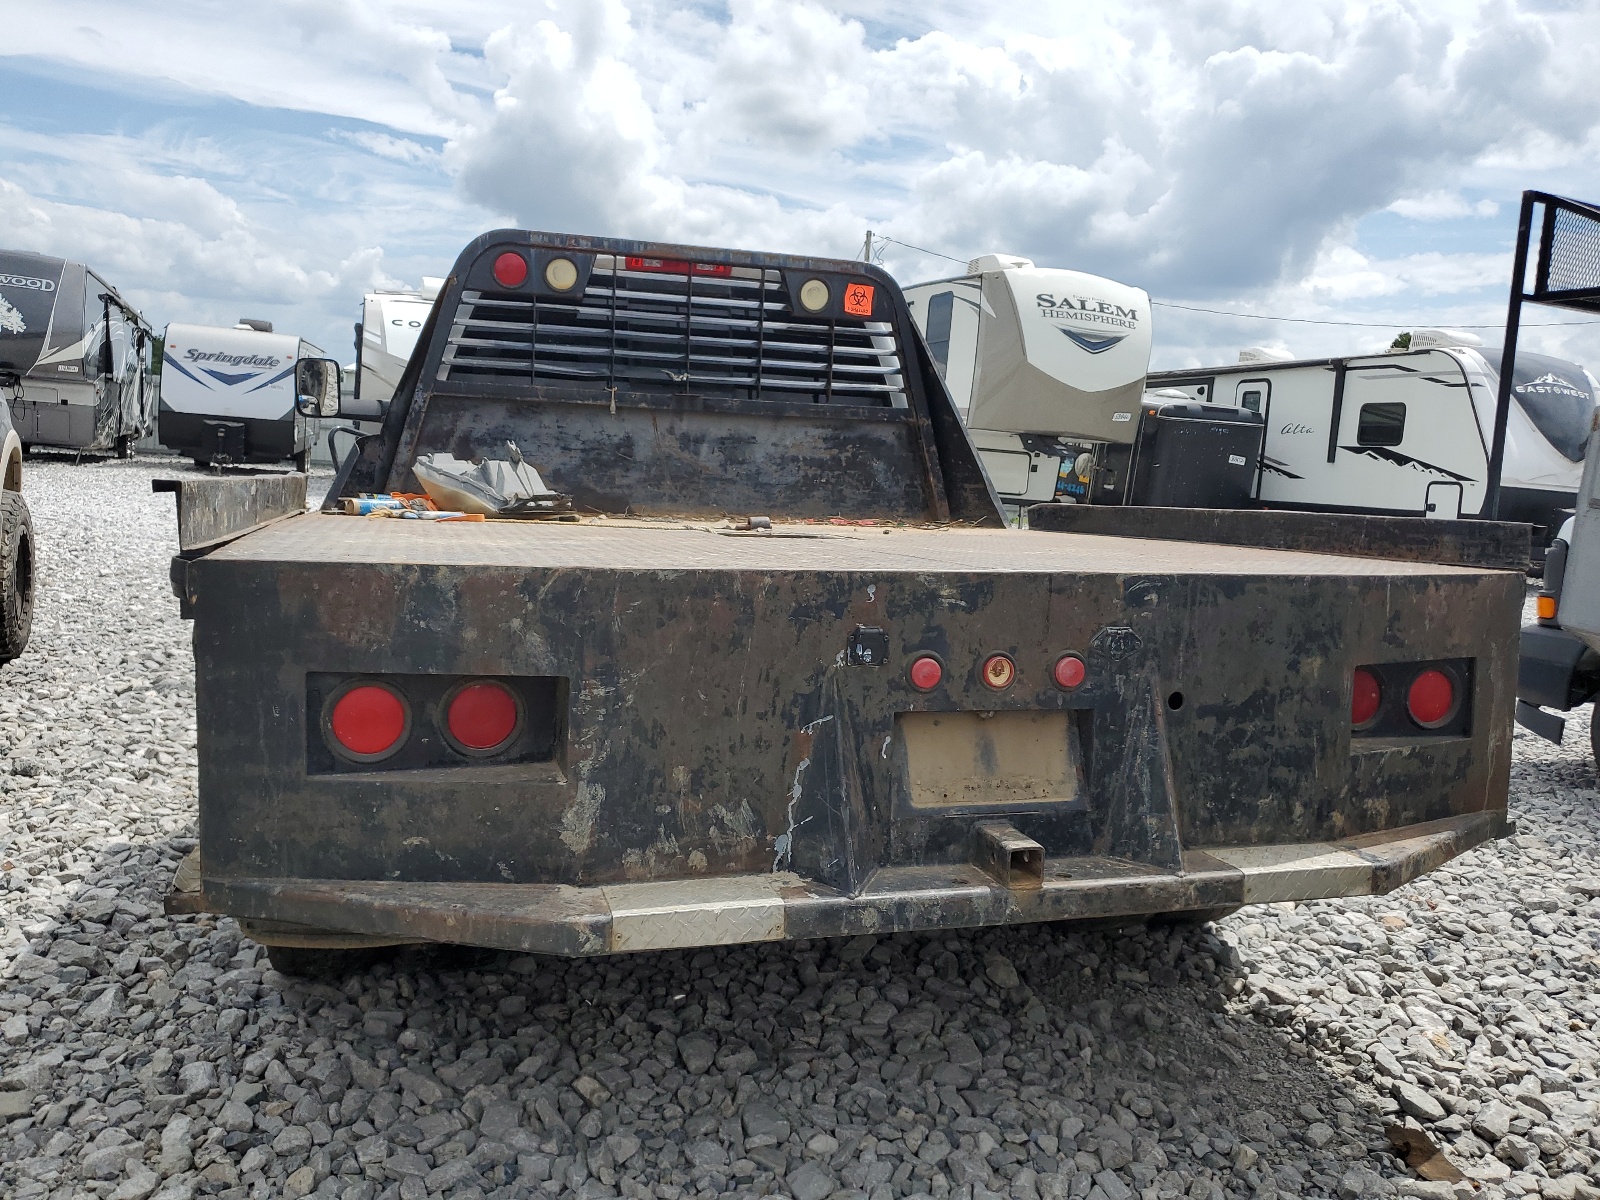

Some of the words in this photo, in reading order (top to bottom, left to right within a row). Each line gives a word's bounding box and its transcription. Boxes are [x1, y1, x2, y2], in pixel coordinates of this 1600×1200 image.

[1036, 293, 1140, 321] SALEM
[1041, 308, 1137, 330] HEMISPHERE
[183, 348, 281, 367] Springdale
[1515, 385, 1551, 394] EAST
[1561, 388, 1590, 400] WEST
[1280, 422, 1315, 435] Alta
